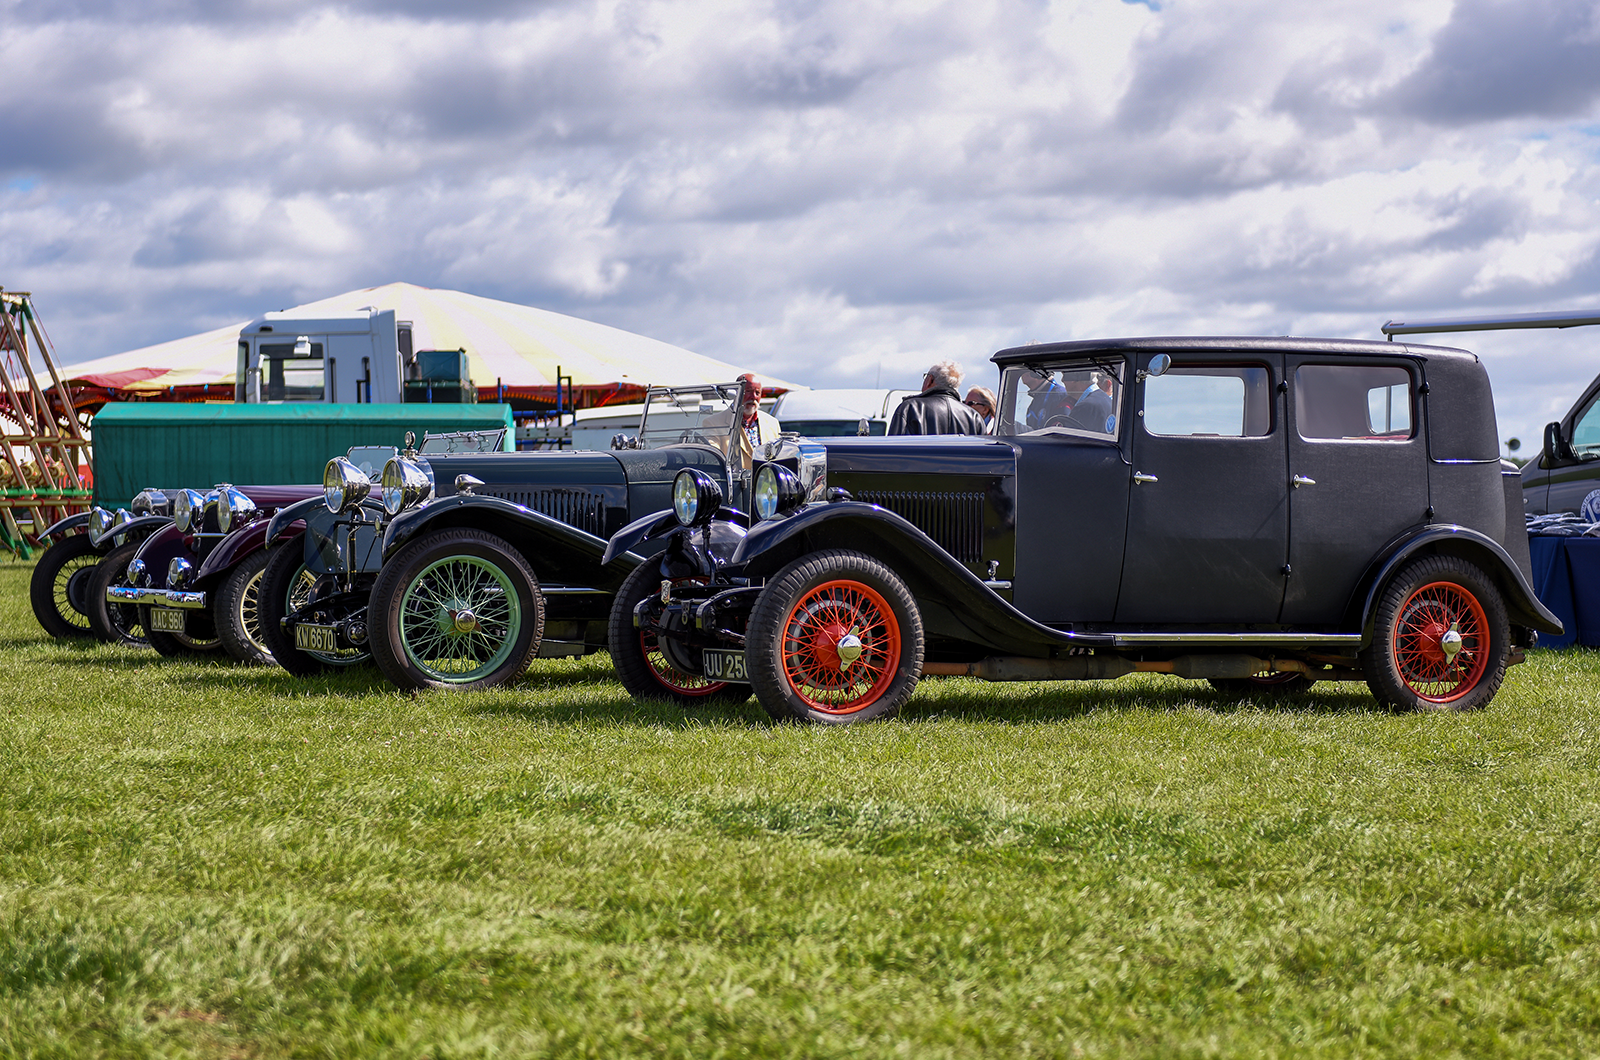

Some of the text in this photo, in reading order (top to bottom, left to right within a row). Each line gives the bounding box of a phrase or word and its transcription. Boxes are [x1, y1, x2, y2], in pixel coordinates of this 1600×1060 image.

[152, 610, 184, 630] AAC 960
[296, 626, 334, 651] KW 6670
[705, 653, 723, 677] UU
